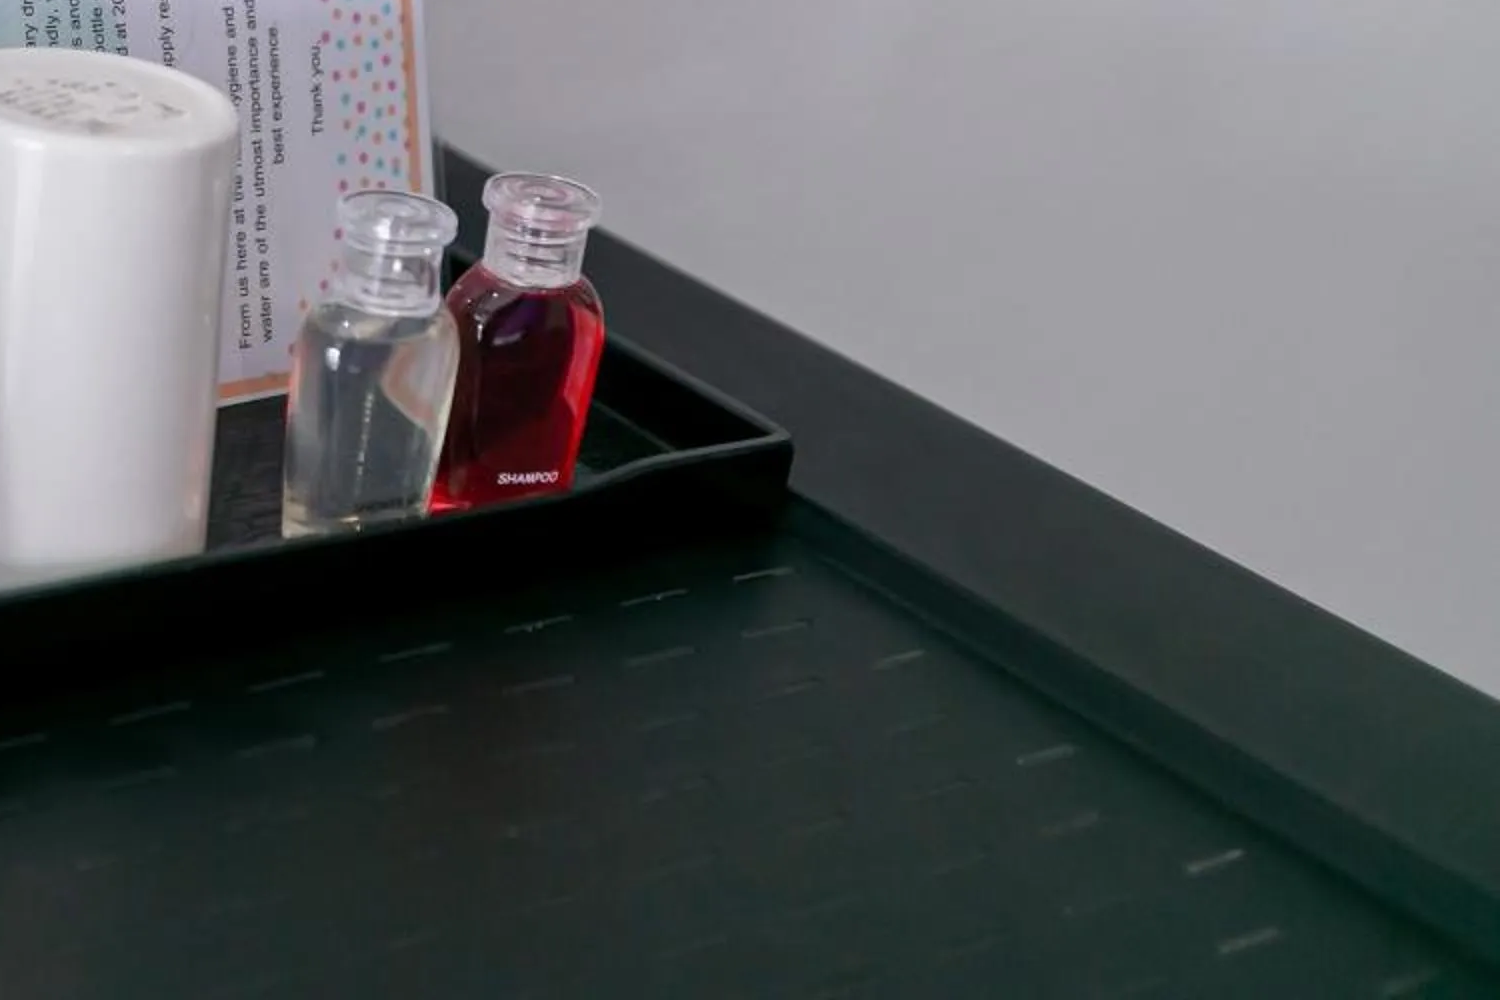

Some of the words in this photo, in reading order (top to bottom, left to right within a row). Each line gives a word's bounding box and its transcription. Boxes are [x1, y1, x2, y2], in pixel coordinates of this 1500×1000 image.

[23, 24, 37, 47] ary
[115, 24, 127, 39] at
[222, 6, 236, 38] and
[226, 45, 242, 106] ygiene
[245, 37, 262, 132] importance
[309, 83, 324, 136] Thank
[271, 127, 285, 165] best
[250, 138, 265, 197] utmost
[233, 209, 245, 224] at
[253, 204, 267, 231] the
[234, 231, 248, 270] here
[255, 237, 269, 253] of
[238, 276, 250, 296] us
[259, 261, 270, 288] are
[238, 303, 253, 349] From
[260, 296, 273, 342] water
[497, 472, 559, 485] SHAMPOO
